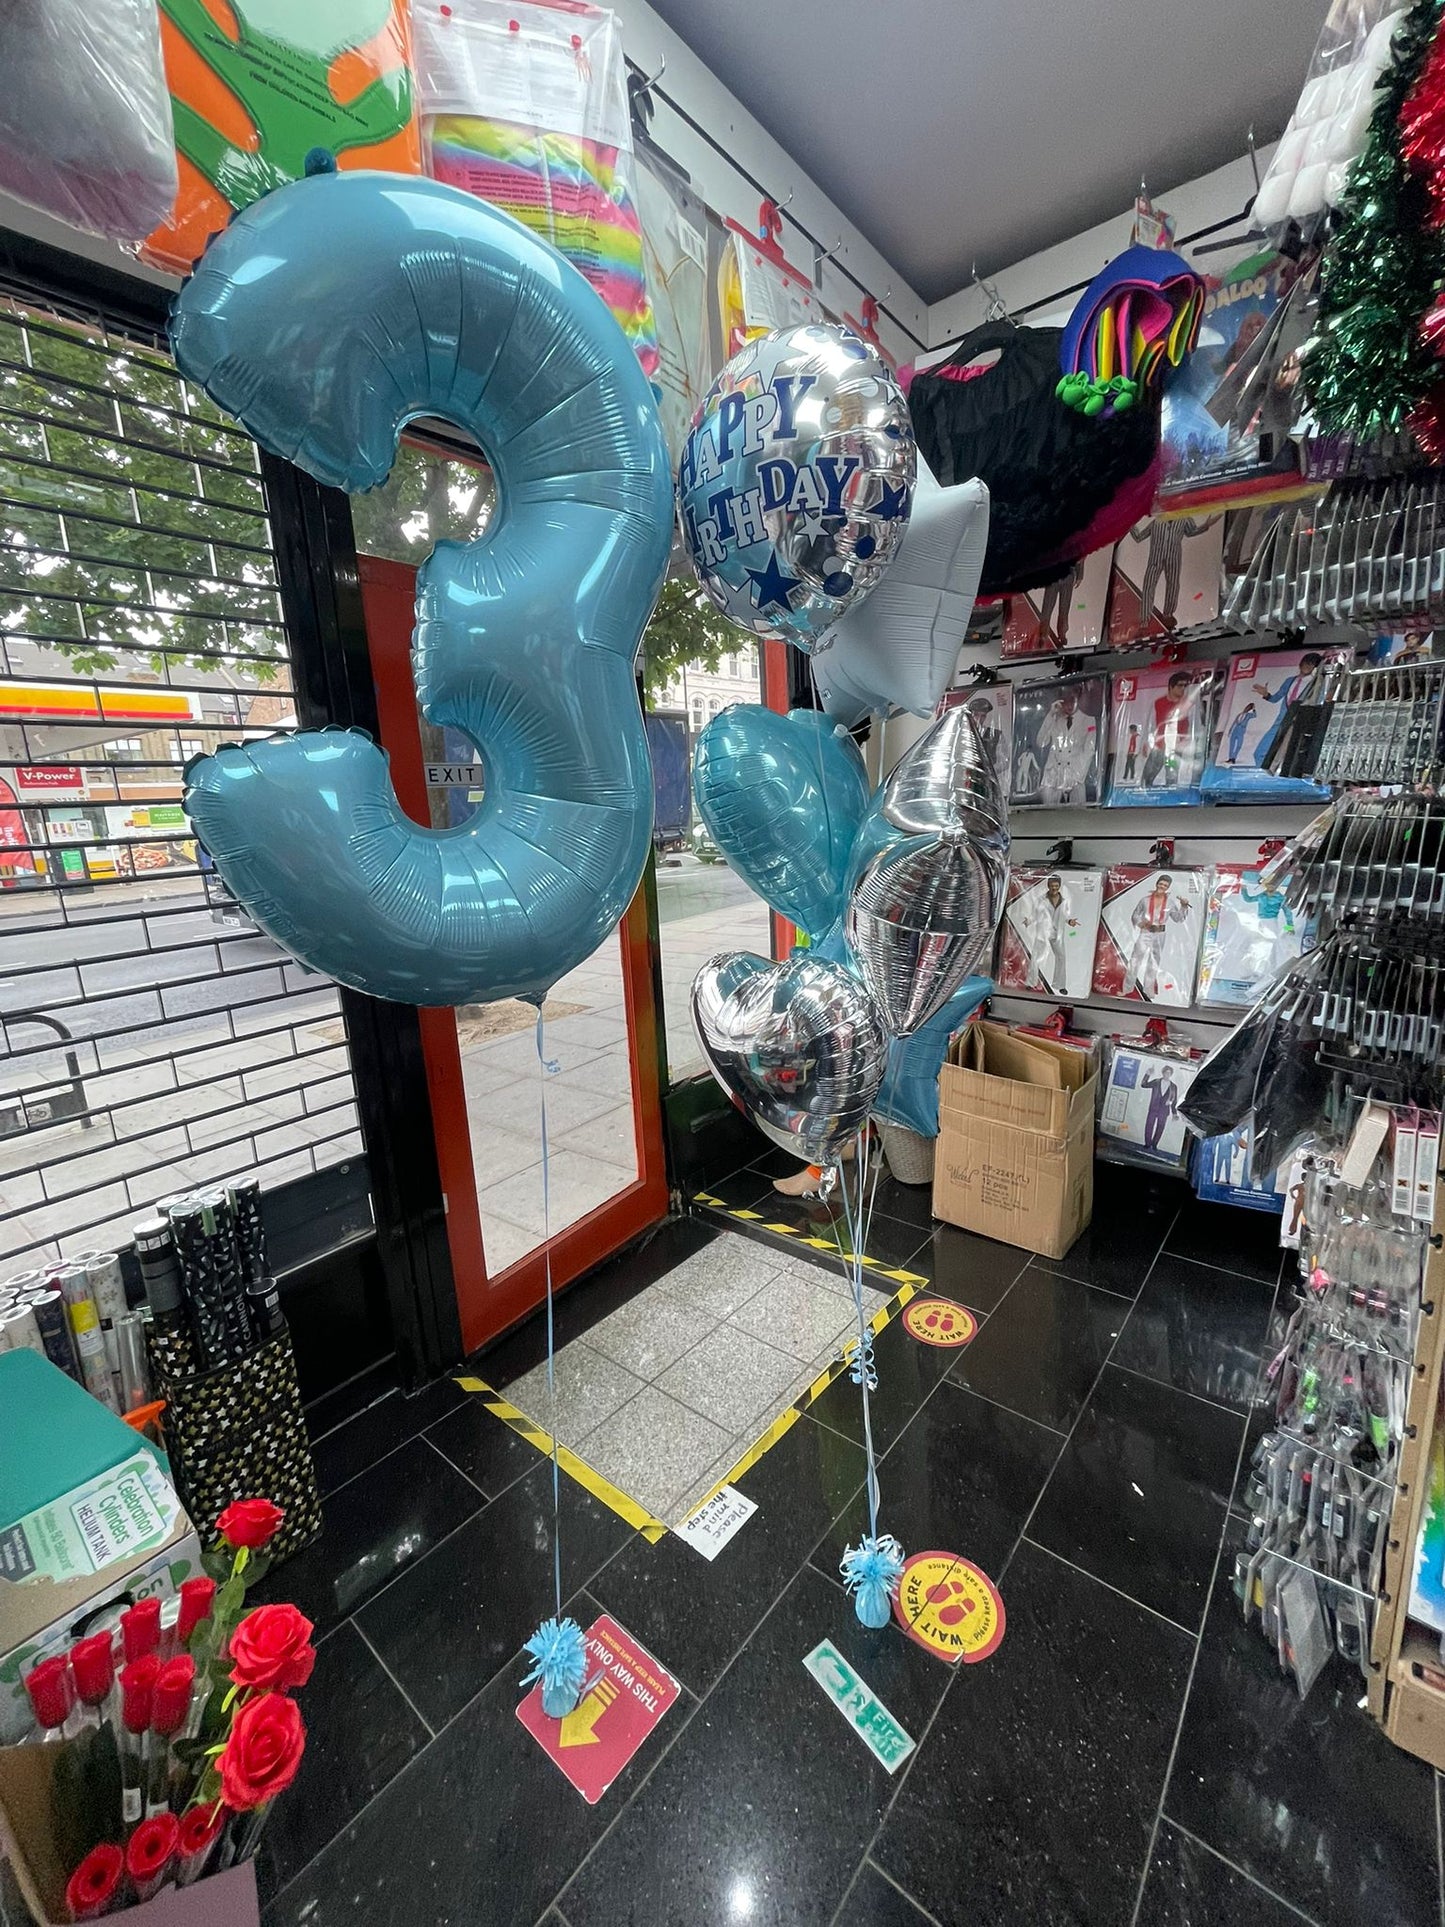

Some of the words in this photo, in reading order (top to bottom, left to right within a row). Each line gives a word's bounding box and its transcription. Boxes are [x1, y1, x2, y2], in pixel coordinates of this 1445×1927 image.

[680, 374, 817, 499] HAPPY
[684, 456, 861, 567] IRTHDAY
[23, 772, 75, 781] V-Power
[428, 768, 475, 782] EXIT
[235, 1293, 252, 1340] CANNON
[912, 1320, 935, 1338] HERE
[939, 1329, 965, 1341] WAIT
[117, 1478, 154, 1537] Celebration
[708, 1491, 728, 1509] the
[98, 1494, 132, 1544] Cylinders
[687, 1508, 709, 1531] step
[702, 1503, 730, 1533] mind
[712, 1502, 748, 1539] Please
[77, 1503, 97, 1538] HELIUM
[90, 1534, 113, 1562] TANK
[963, 1570, 978, 1587] safe
[906, 1576, 922, 1618] HERE
[600, 1629, 623, 1654] DISTANCE
[920, 1622, 963, 1646] WAIT
[586, 1638, 614, 1665] ONLY
[621, 1650, 634, 1664] SAFE
[610, 1662, 635, 1689] WAY
[634, 1664, 649, 1680] KEEP
[647, 1674, 667, 1696] PLEASE
[633, 1683, 659, 1713] THIS
[872, 1711, 906, 1748] Fire
